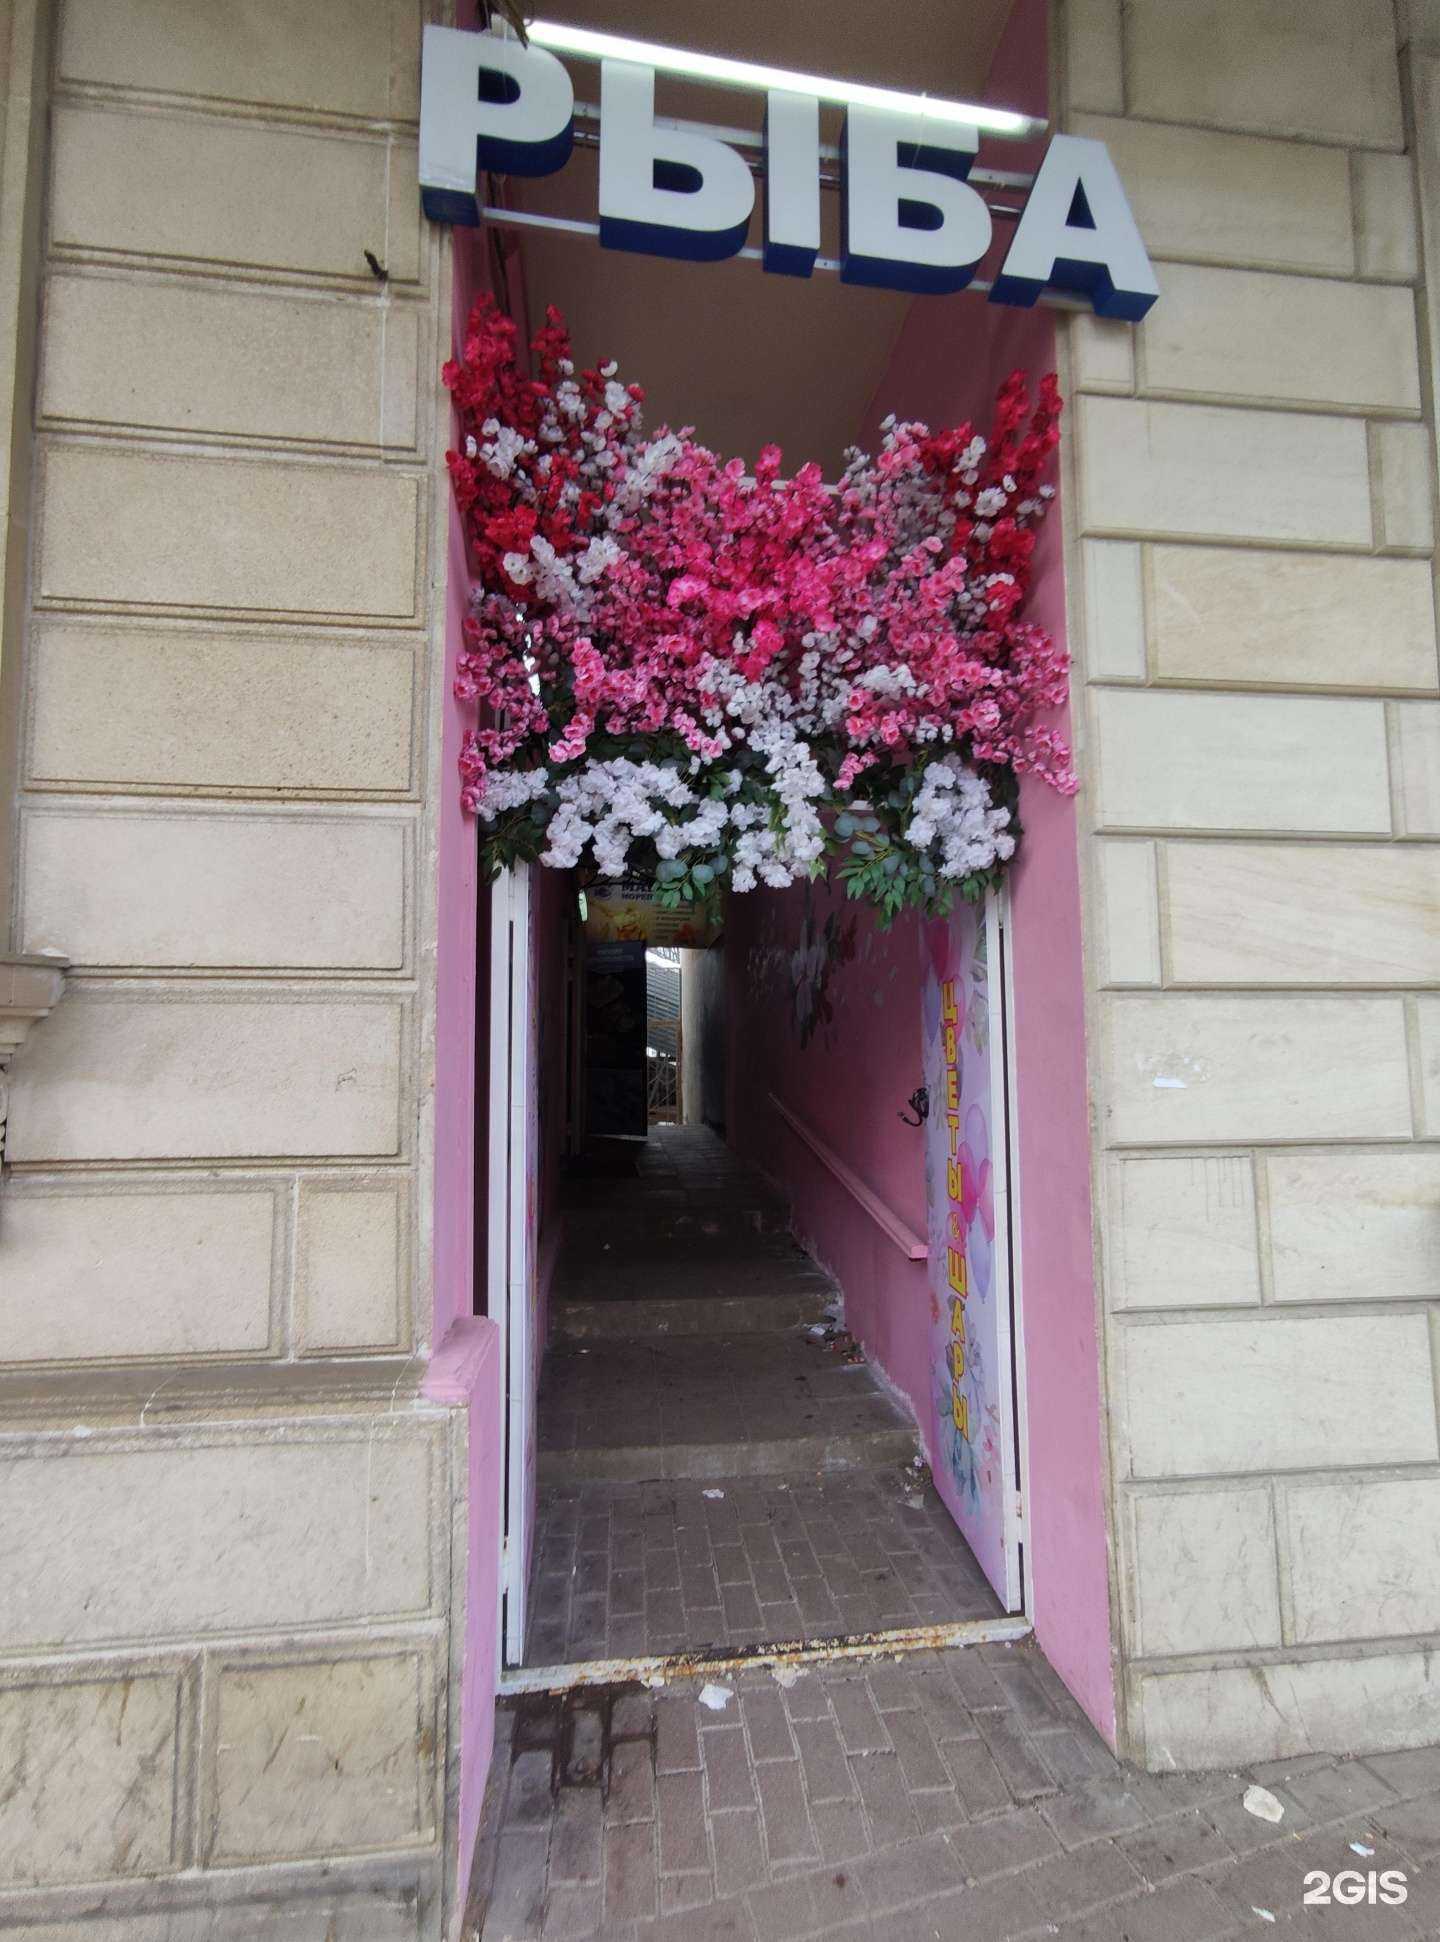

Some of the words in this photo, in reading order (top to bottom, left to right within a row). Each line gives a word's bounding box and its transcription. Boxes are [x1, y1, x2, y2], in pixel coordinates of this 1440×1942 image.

[419, 24, 1160, 312] РЫБА
[942, 980, 964, 1203] ЦВЕТЫ
[947, 1247, 968, 1441] ШАРЫ
